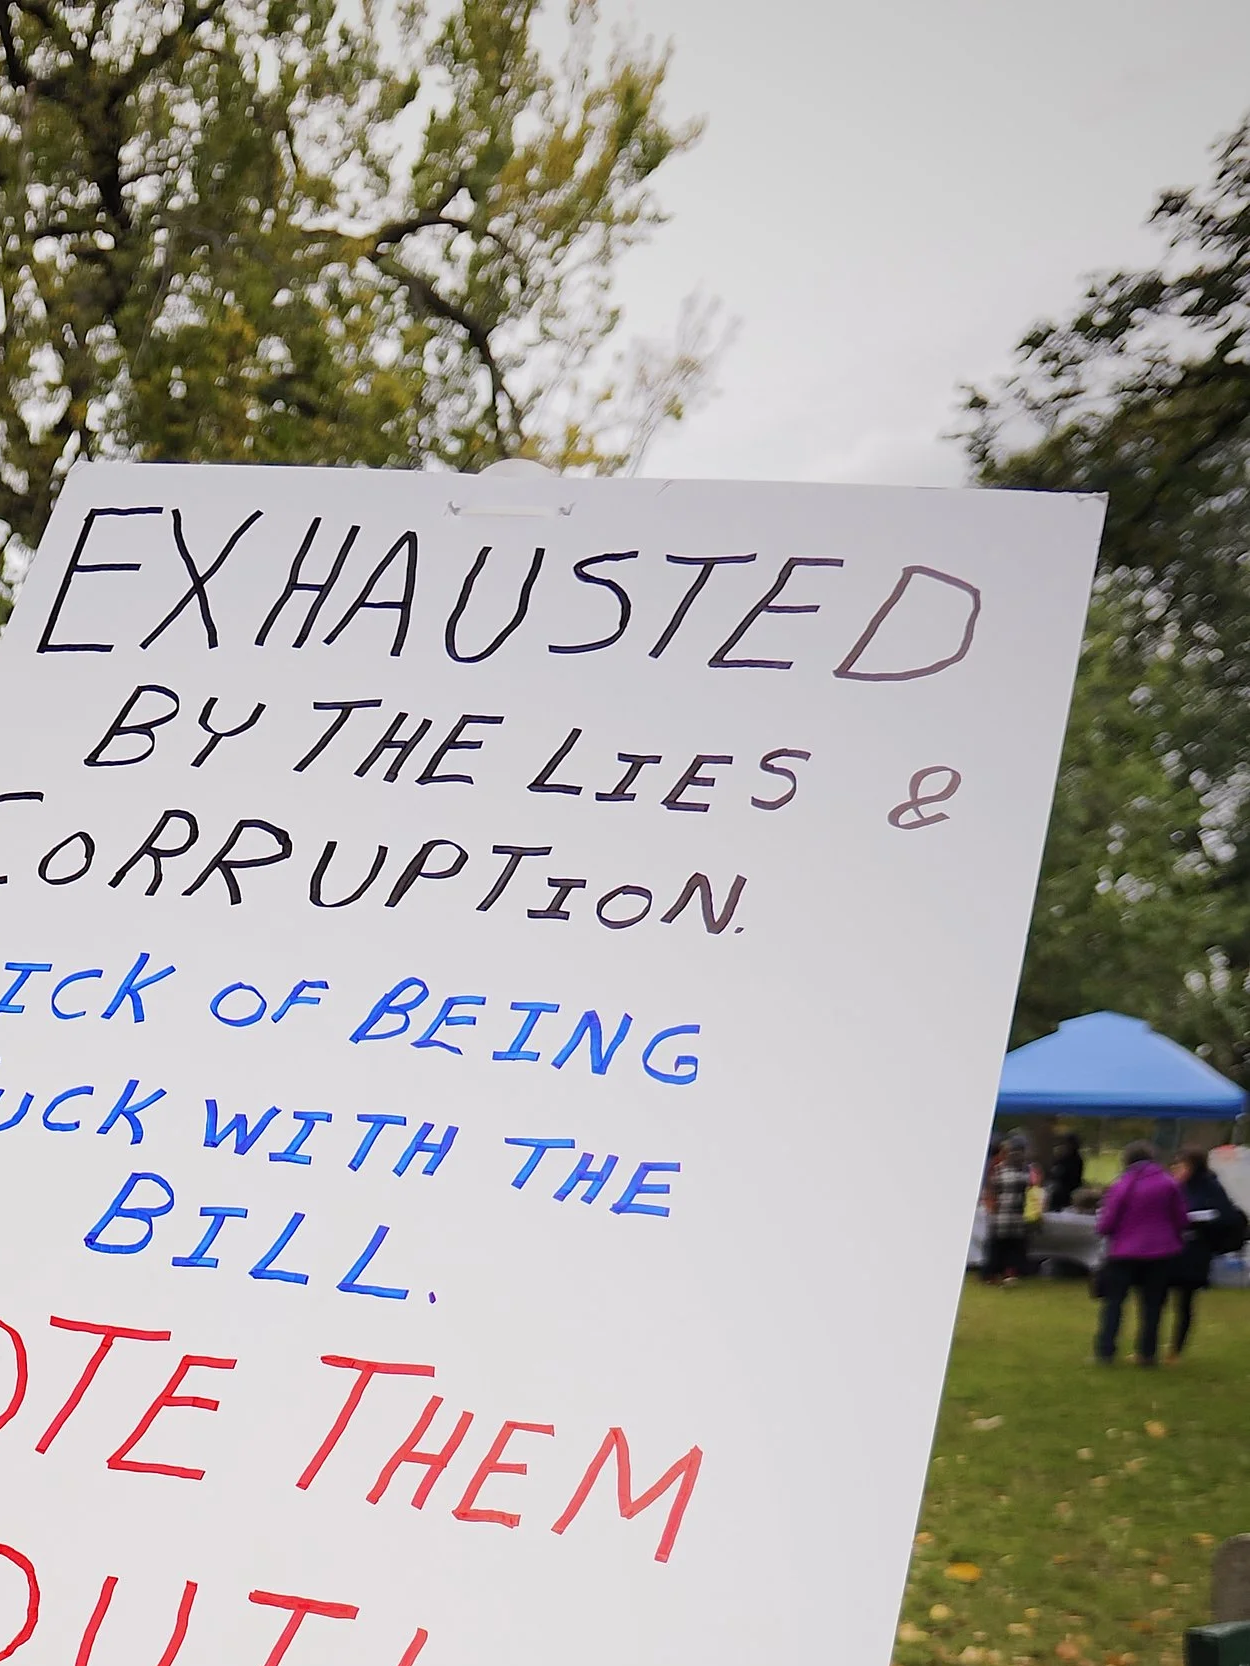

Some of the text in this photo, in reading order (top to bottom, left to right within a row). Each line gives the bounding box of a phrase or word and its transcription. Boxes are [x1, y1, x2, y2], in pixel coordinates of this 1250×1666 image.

[36, 507, 981, 681] EXHAUSTED
[83, 685, 961, 830] BY THE LIES &
[210, 977, 329, 1027] OF
[349, 977, 700, 1085] BEING
[203, 1099, 459, 1177] WITH
[504, 1137, 680, 1217] THE
[83, 1172, 436, 1304] BILL.
[295, 1355, 703, 1563] THEM
